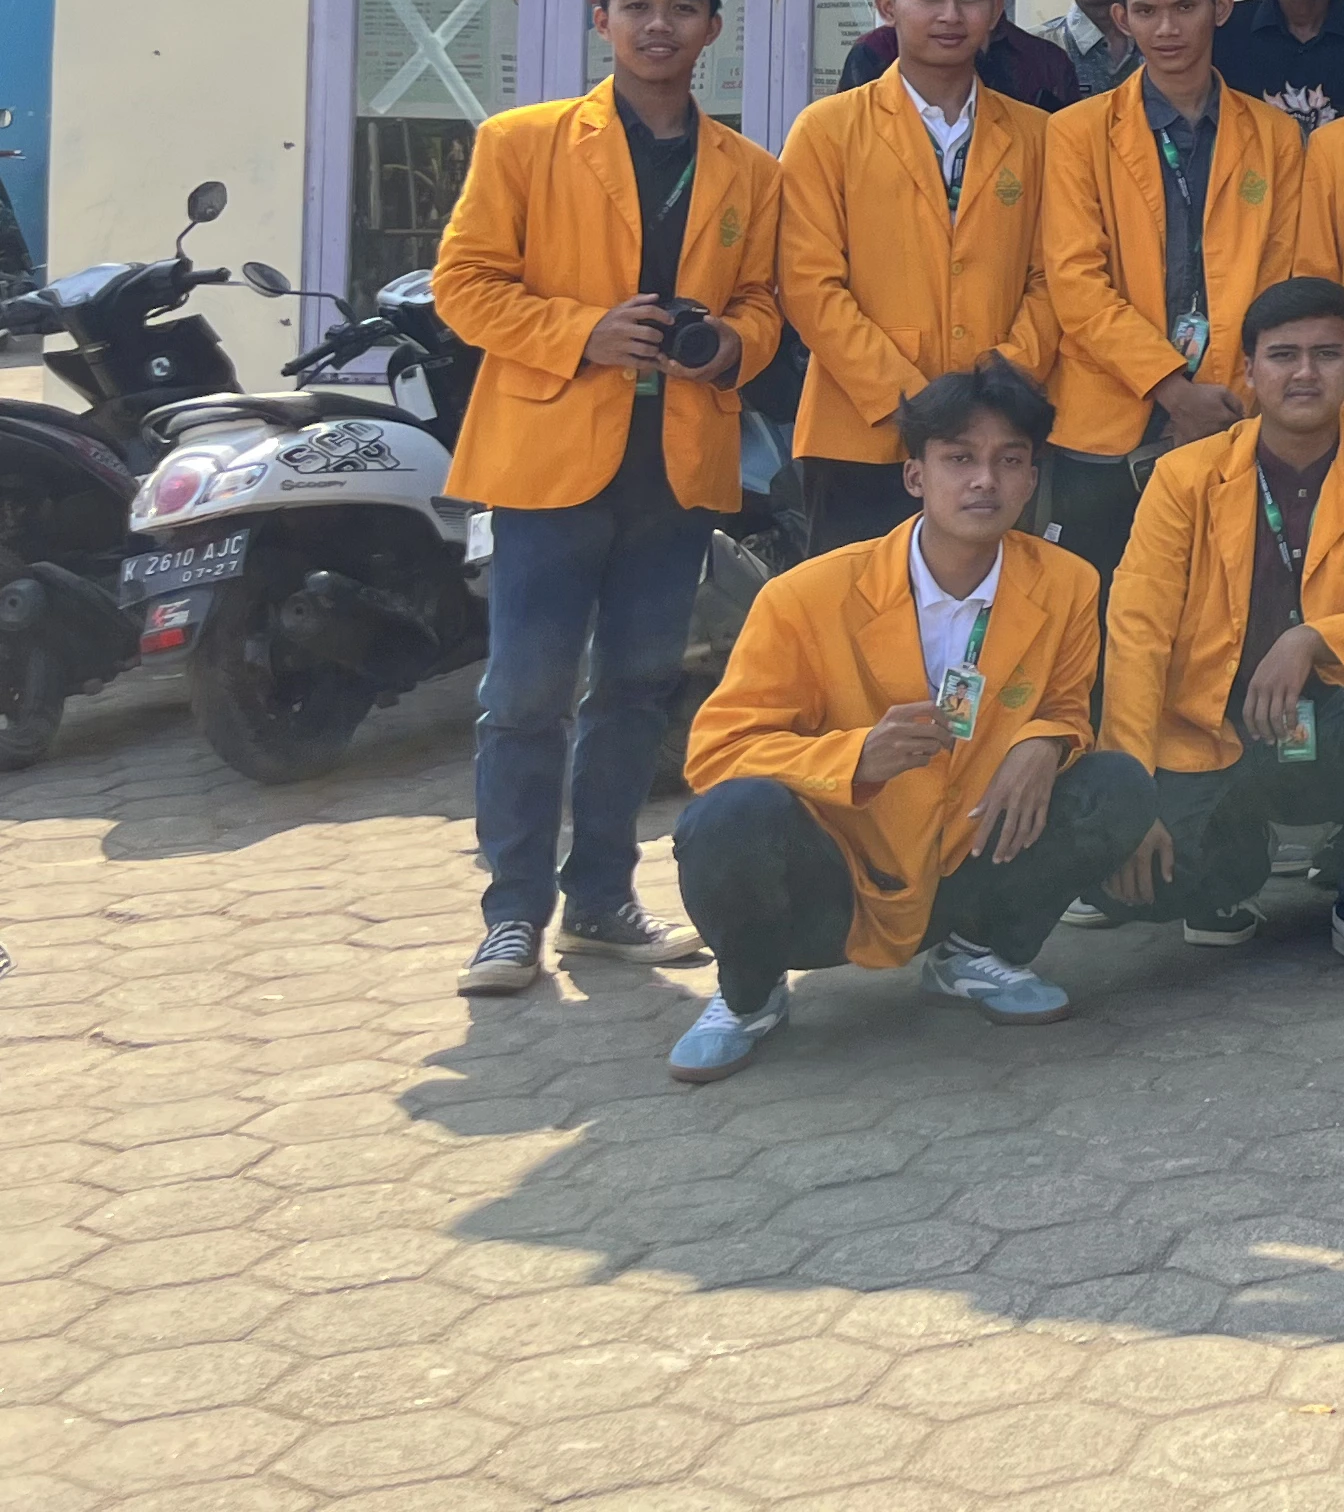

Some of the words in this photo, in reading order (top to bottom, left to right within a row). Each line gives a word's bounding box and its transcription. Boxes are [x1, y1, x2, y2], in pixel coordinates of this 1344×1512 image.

[123, 560, 137, 583] K
[144, 548, 195, 576] 2610
[203, 535, 244, 561] AJC
